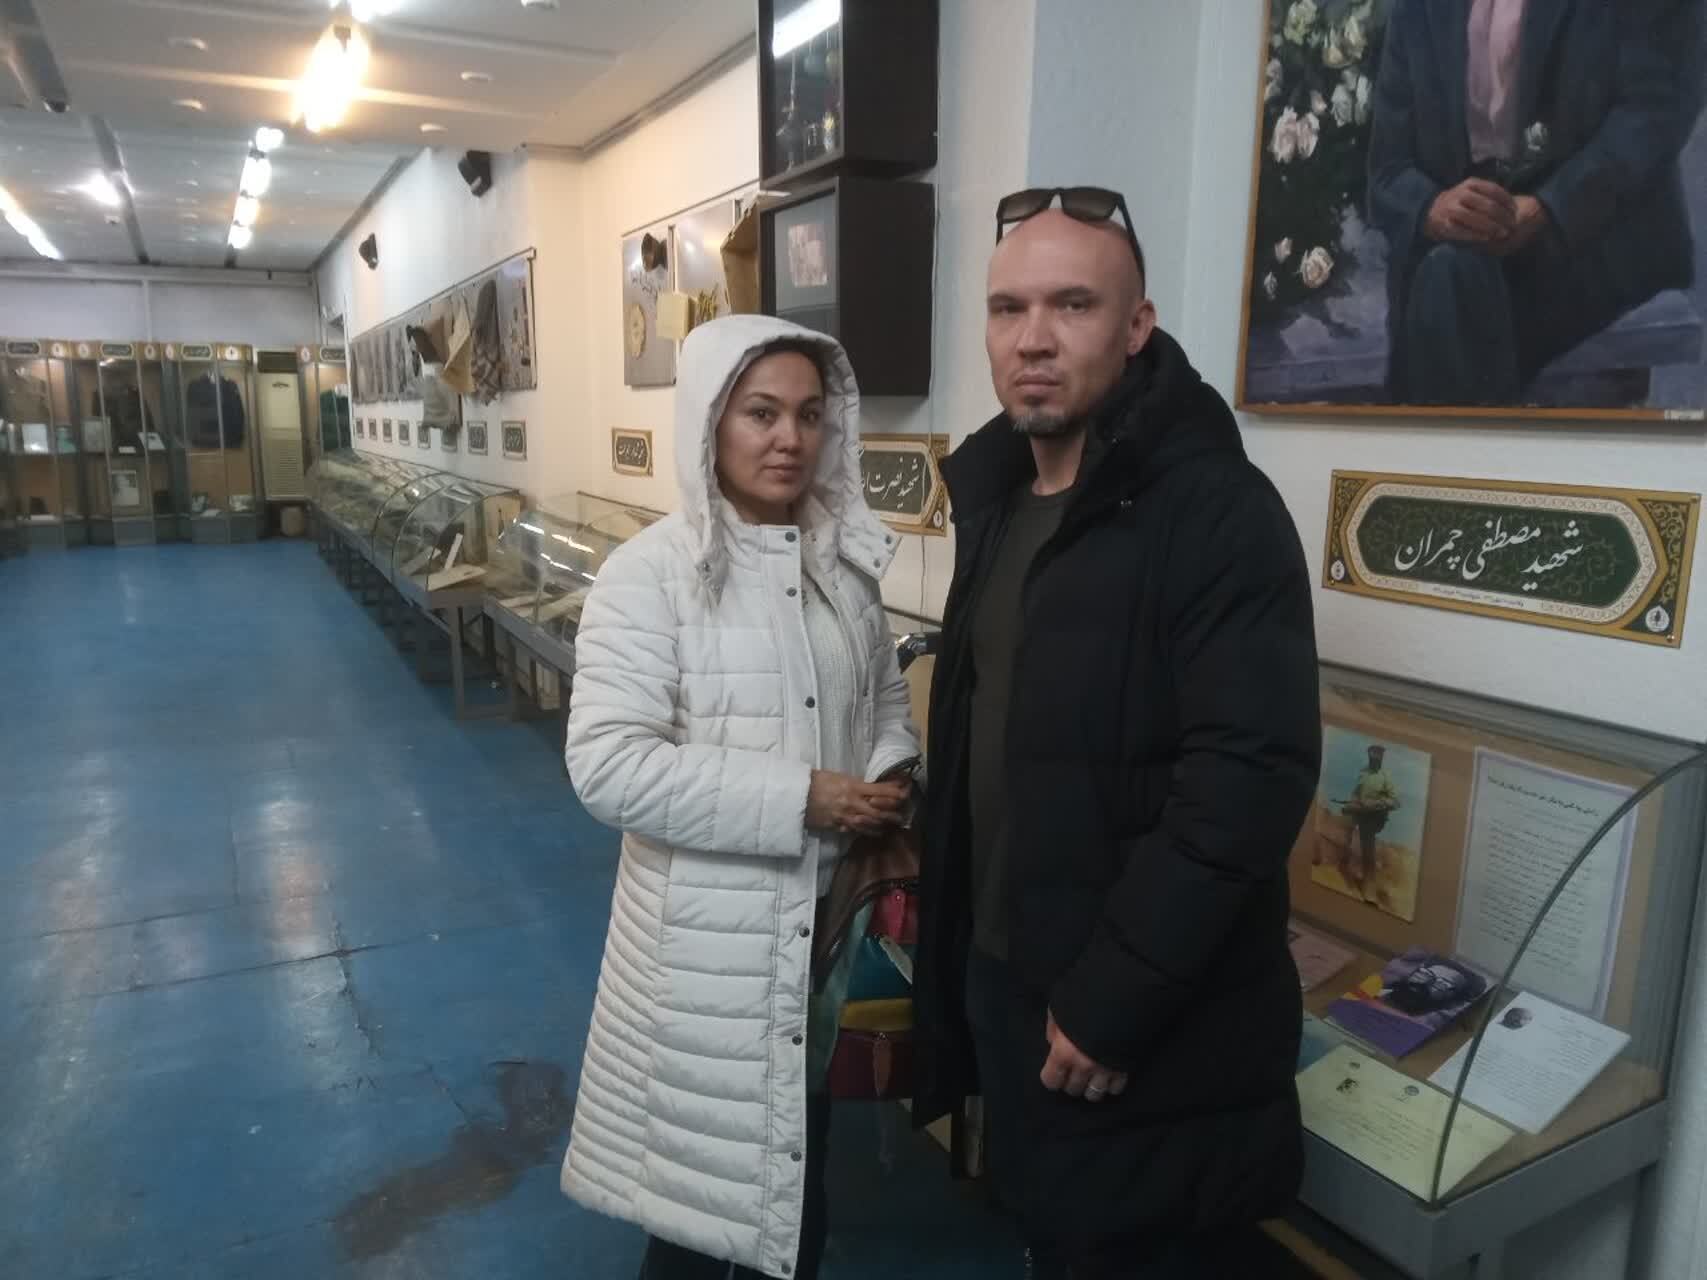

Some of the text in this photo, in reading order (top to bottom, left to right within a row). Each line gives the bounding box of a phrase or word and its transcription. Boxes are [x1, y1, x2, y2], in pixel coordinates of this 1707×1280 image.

[896, 458, 920, 509] شهید
[1394, 516, 1586, 591] شهید مصطفی چمران
